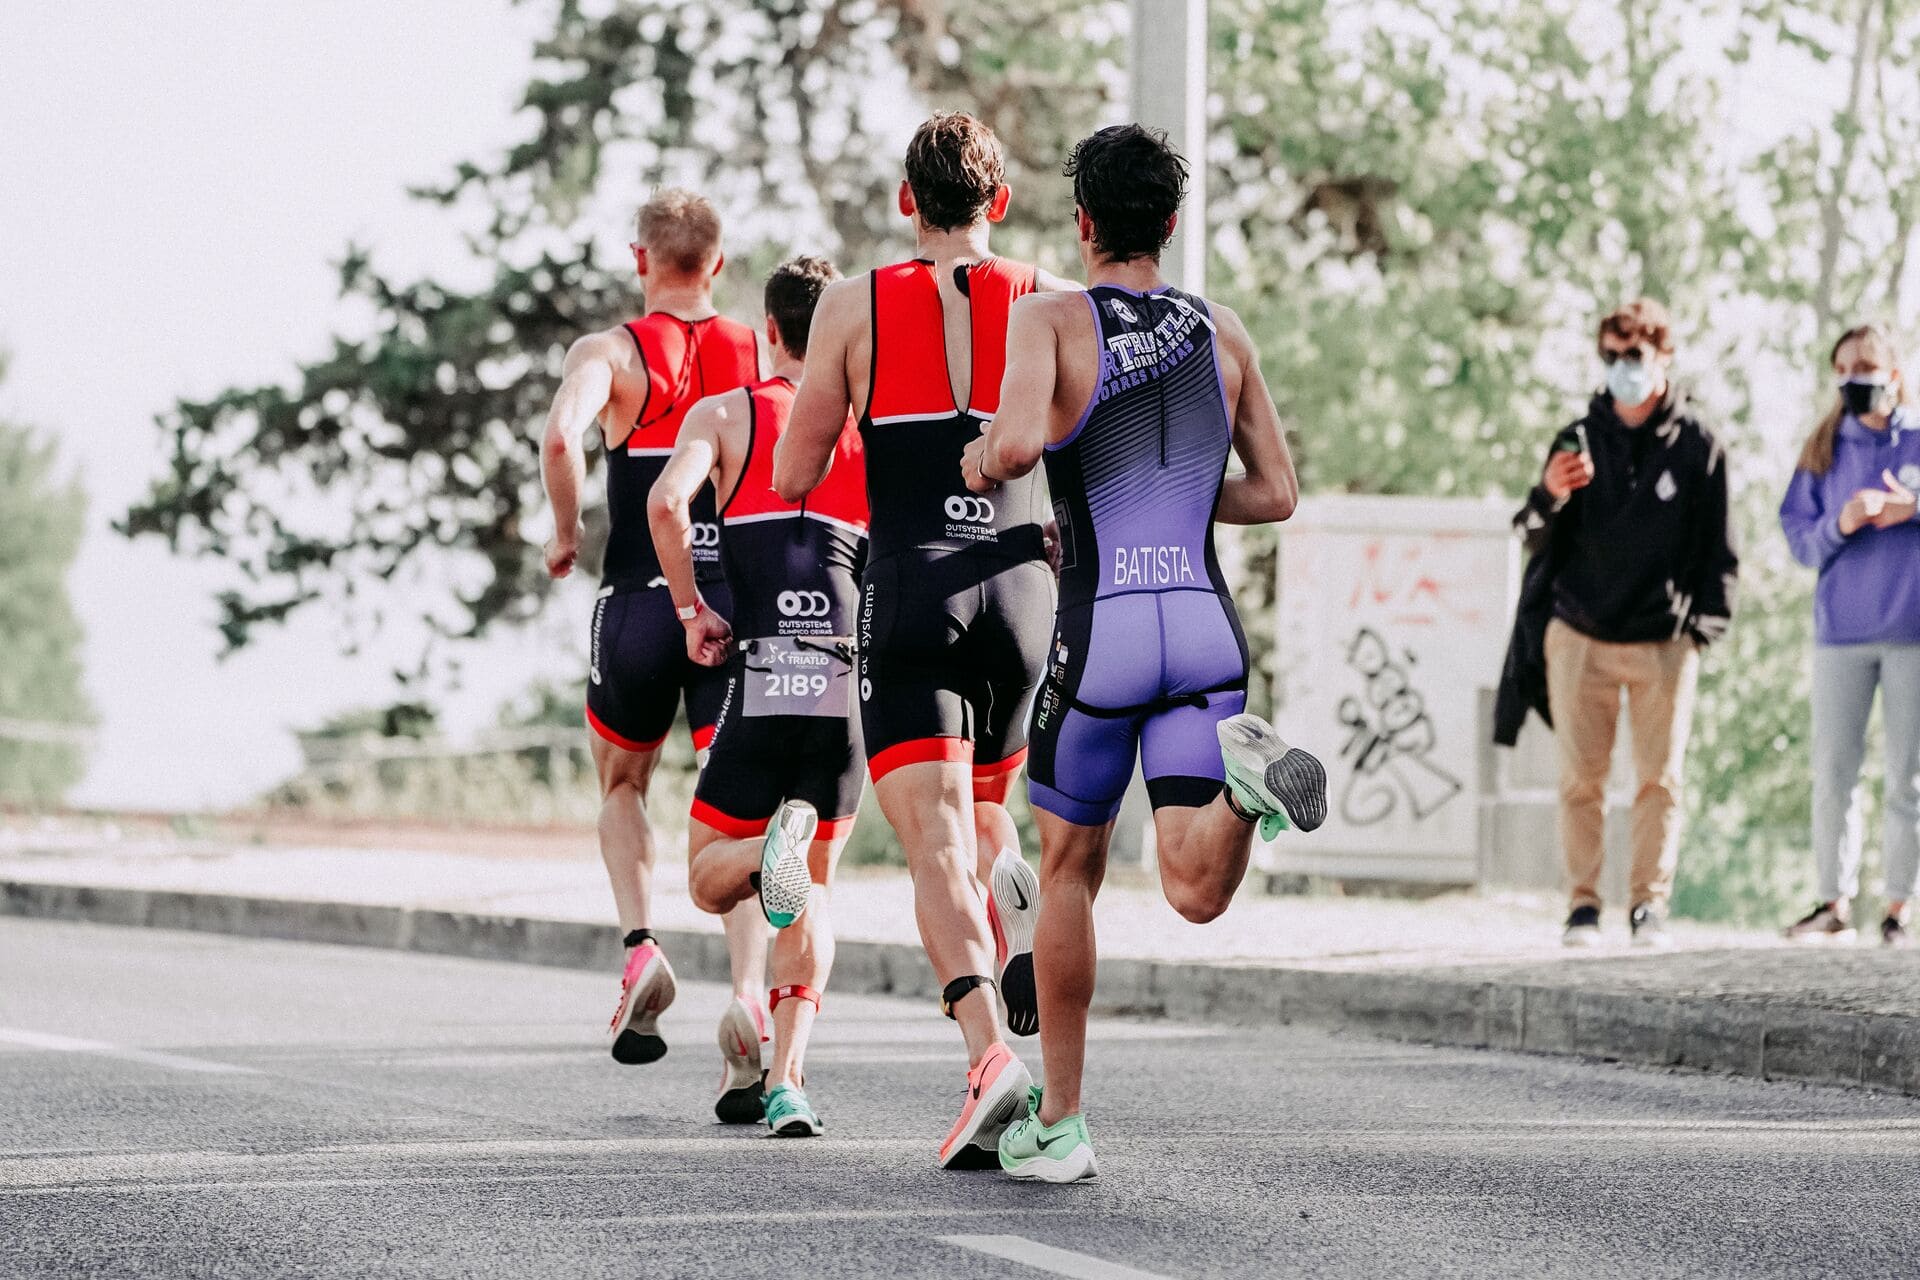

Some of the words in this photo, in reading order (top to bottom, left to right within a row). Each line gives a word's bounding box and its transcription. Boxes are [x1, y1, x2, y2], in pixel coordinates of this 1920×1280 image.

[1150, 339, 1195, 380] NOVAS
[945, 523, 998, 536] OUTSYSTEMS
[1114, 546, 1195, 585] BATISTA
[778, 620, 832, 629] OUTSYSTEMS
[787, 656, 829, 666] TRIATLO
[765, 674, 828, 697] 2189
